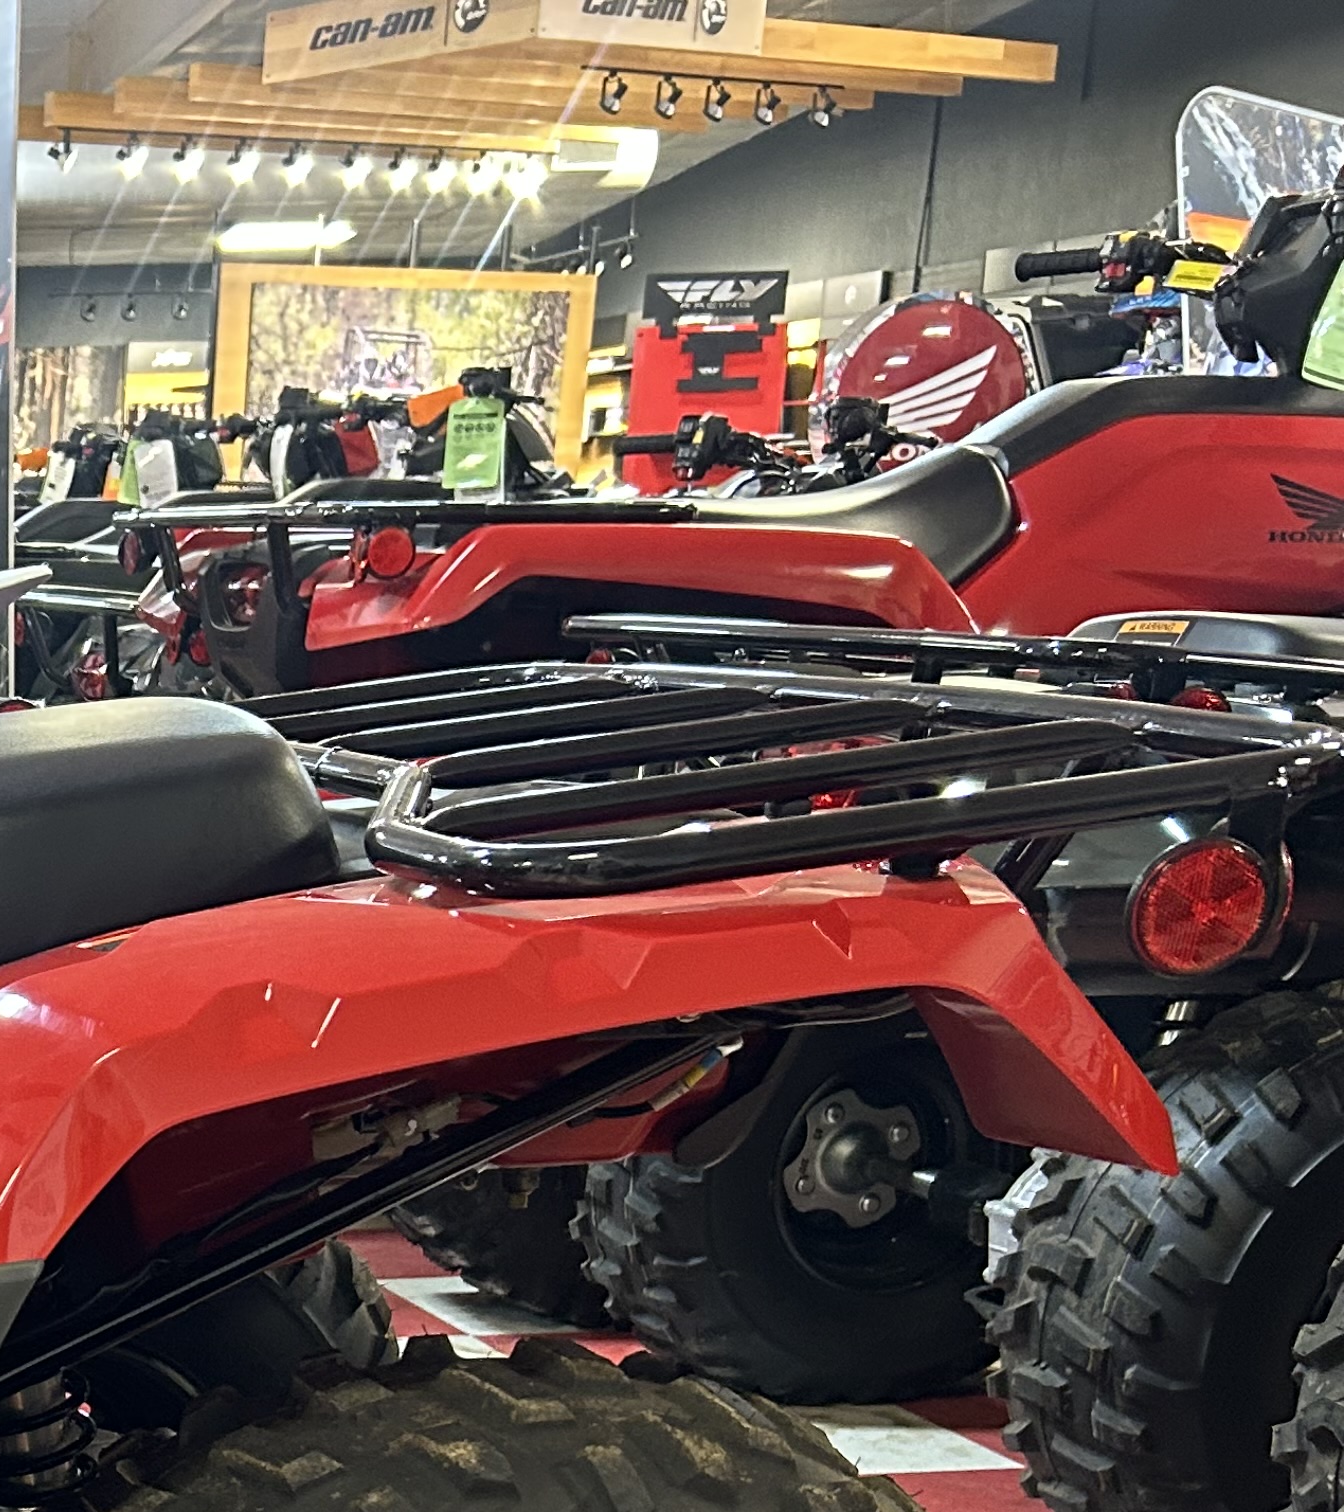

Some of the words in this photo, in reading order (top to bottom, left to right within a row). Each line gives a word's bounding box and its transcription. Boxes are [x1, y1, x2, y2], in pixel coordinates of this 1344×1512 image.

[309, 6, 433, 51] can-am
[657, 279, 779, 302] FLY
[1269, 530, 1344, 543] HOND
